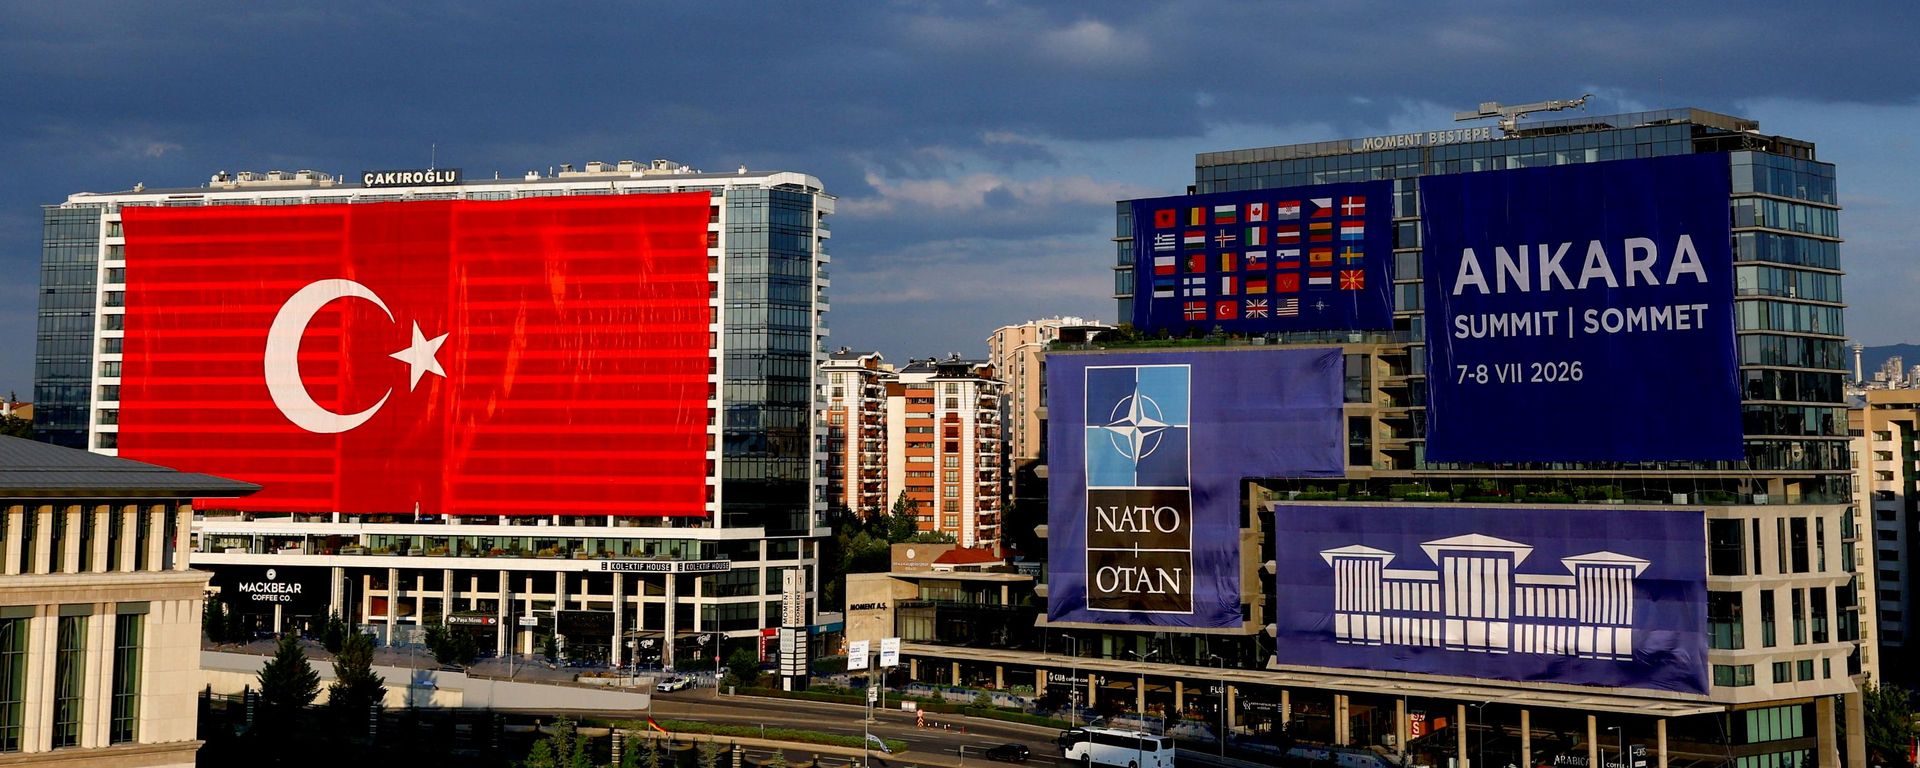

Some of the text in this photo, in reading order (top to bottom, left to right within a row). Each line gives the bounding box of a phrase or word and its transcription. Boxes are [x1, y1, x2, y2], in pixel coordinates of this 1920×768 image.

[1362, 133, 1423, 150] MOMENT
[364, 169, 456, 187] ÇAKIROĞLU
[1452, 234, 1708, 295] ANKARA
[1454, 311, 1558, 339] SUMMIT
[1583, 303, 1709, 334] SOMMET
[1456, 361, 1584, 385] 7-8 VII 2026
[1095, 505, 1180, 533] NATO
[646, 562, 670, 571] HOUSE
[712, 562, 728, 570] HOUSE
[239, 582, 302, 593] MACKBEAR
[1096, 565, 1182, 594] OTAN
[279, 594, 292, 602] CO.
[850, 603, 876, 611] MOMENT
